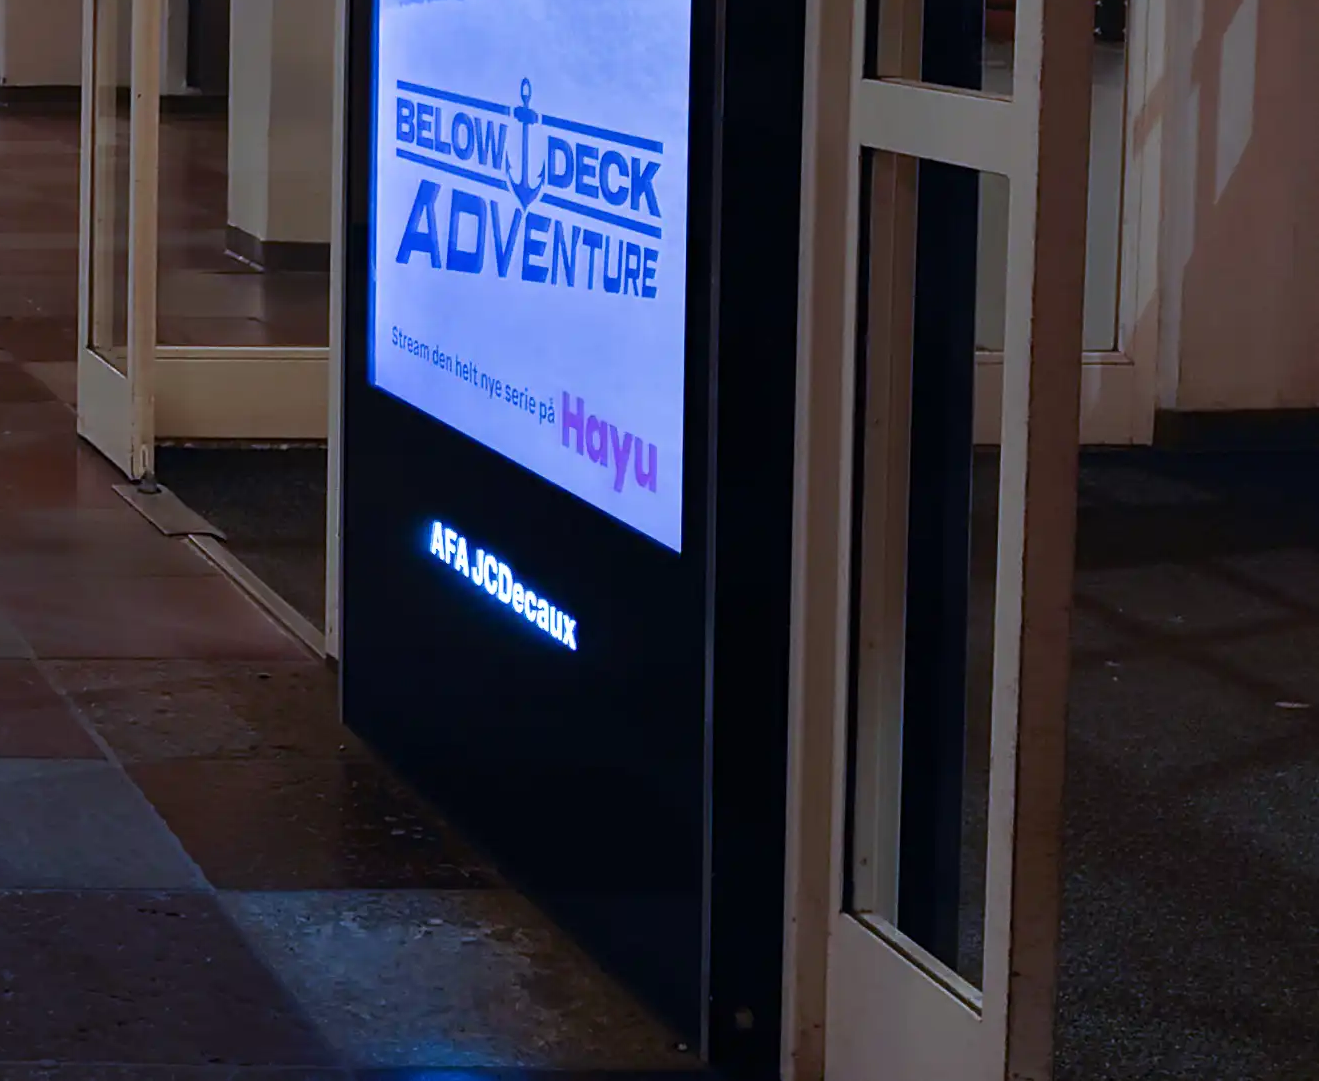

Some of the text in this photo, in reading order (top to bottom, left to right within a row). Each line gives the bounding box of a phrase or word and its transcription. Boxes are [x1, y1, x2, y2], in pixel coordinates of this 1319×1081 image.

[396, 95, 662, 218] BELOW DECK
[395, 179, 660, 299] ADVENTURE
[391, 325, 658, 494] Stream den helt nye serie på Hayu
[430, 521, 577, 651] AFA JCDecaux
